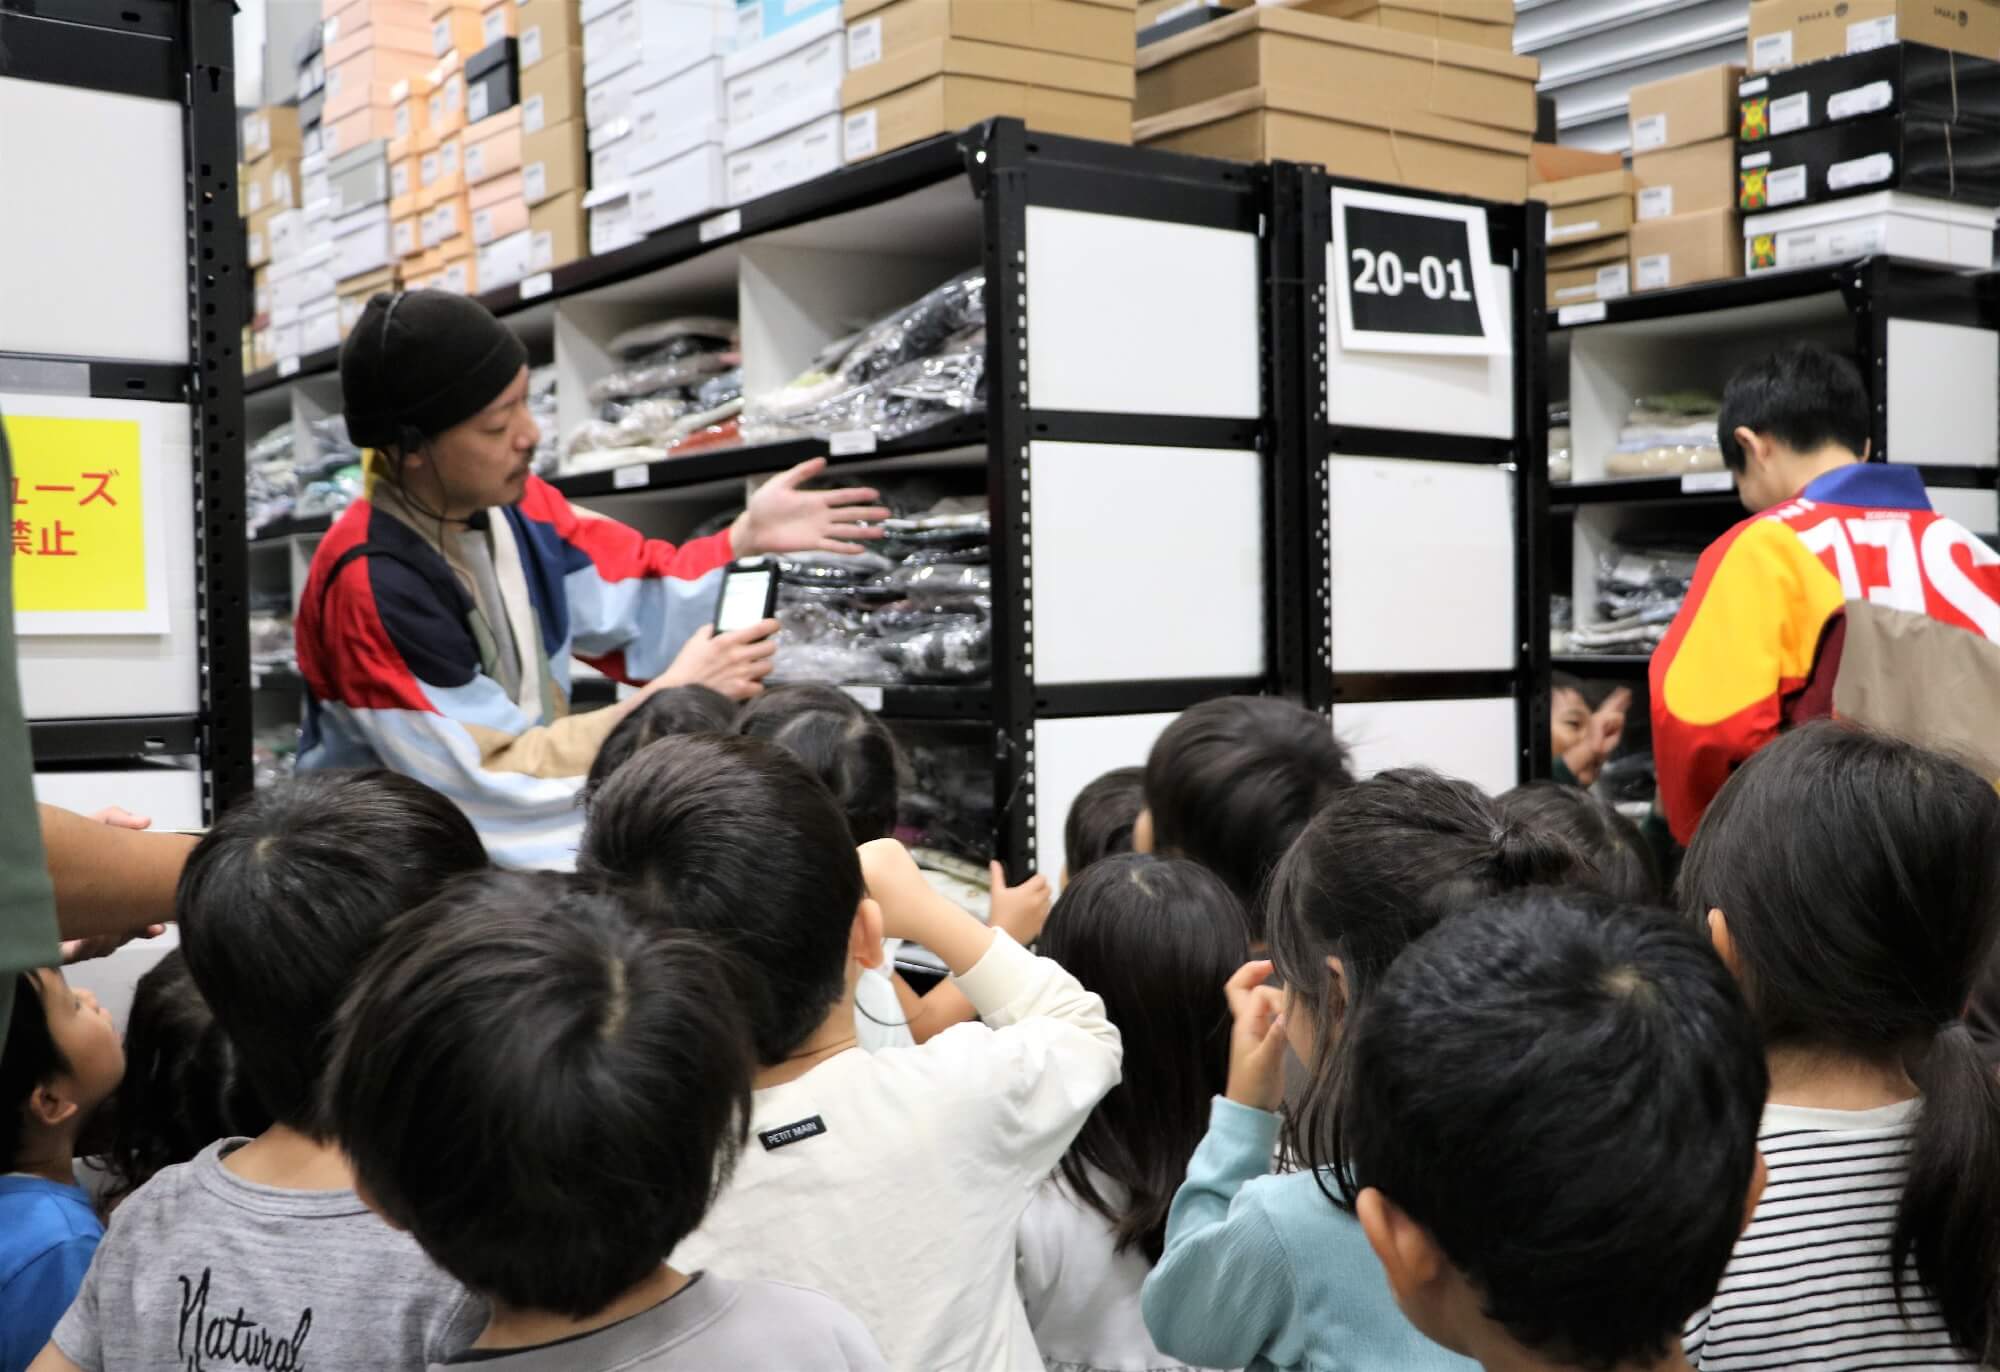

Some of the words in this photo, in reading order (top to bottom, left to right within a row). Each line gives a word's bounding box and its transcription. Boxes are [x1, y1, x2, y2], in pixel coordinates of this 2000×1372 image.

[1351, 247, 1472, 301] 20-01
[767, 1130, 792, 1144] PETIT
[792, 1121, 818, 1136] MAIN
[178, 1266, 313, 1372] Natural
